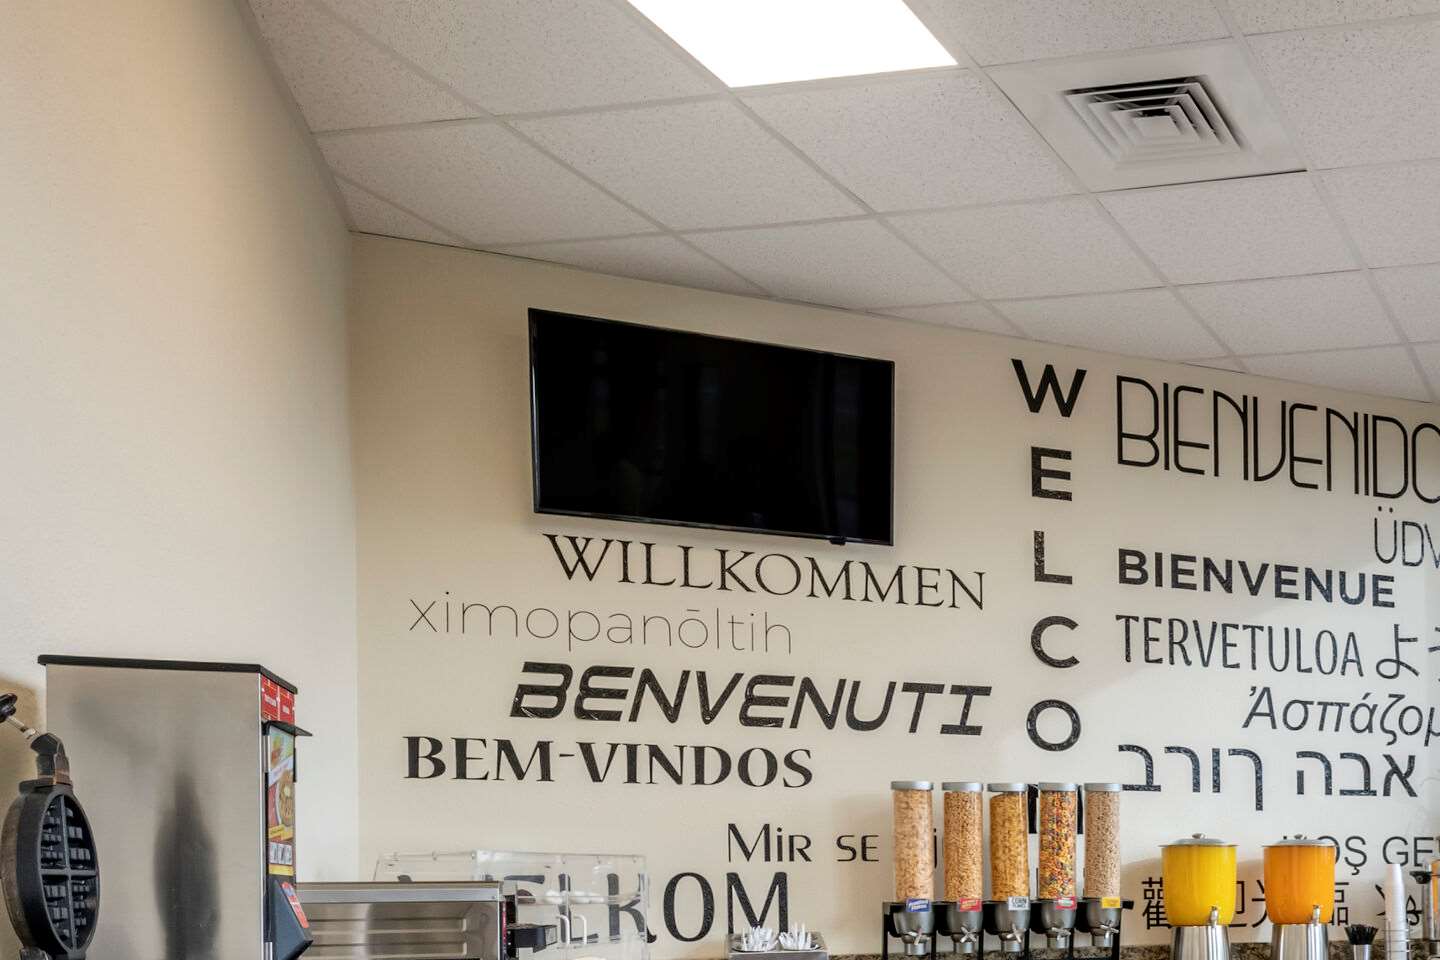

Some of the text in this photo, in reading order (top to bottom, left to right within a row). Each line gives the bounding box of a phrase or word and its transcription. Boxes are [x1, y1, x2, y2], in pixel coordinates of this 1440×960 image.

[542, 533, 988, 611] WILLKOMMEN
[1117, 548, 1396, 609] BIENVENUE
[408, 591, 792, 655] ximopanōltih
[1115, 614, 1365, 678] TERVETULOA
[508, 661, 993, 737] BENVENUTI
[402, 735, 814, 788] BEM-VINDOS
